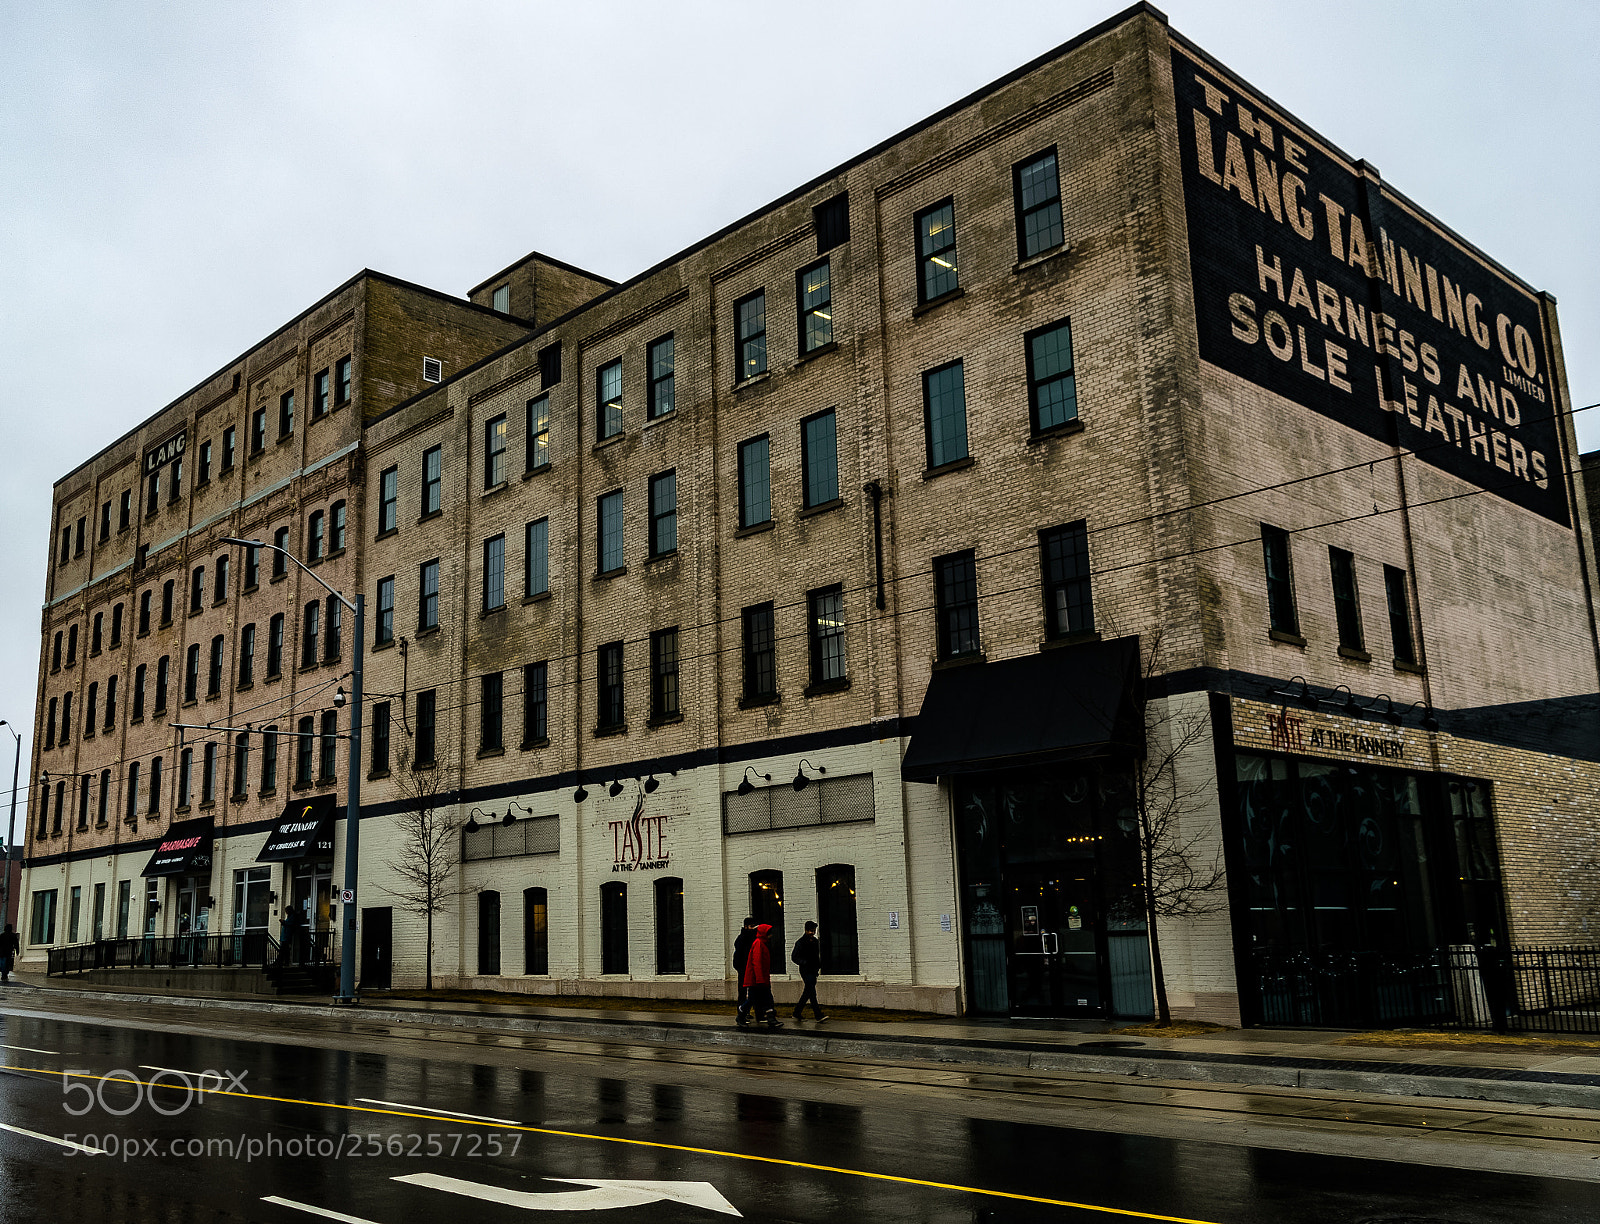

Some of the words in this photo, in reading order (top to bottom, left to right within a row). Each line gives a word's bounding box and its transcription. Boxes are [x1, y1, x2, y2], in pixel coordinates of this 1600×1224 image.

[1194, 73, 1309, 174] THE
[1193, 108, 1314, 240] LANG
[1319, 192, 1490, 350] TANNING
[1497, 313, 1544, 384] CO.
[1255, 244, 1442, 385] HARNESS
[1457, 363, 1521, 427] AND
[1228, 291, 1352, 394] SOLE
[1374, 365, 1548, 490] LEATHERS
[1502, 365, 1545, 402] LIMITED
[148, 434, 186, 470] LANG
[1266, 711, 1306, 754] TASTE
[1311, 728, 1324, 747] AT
[1327, 731, 1352, 750] THE
[1351, 735, 1405, 759] TANNERY
[318, 841, 332, 849] 121
[608, 809, 669, 871] TASTE
[612, 864, 620, 872] AT
[620, 863, 633, 872] THE
[639, 860, 669, 871] TANNERY
